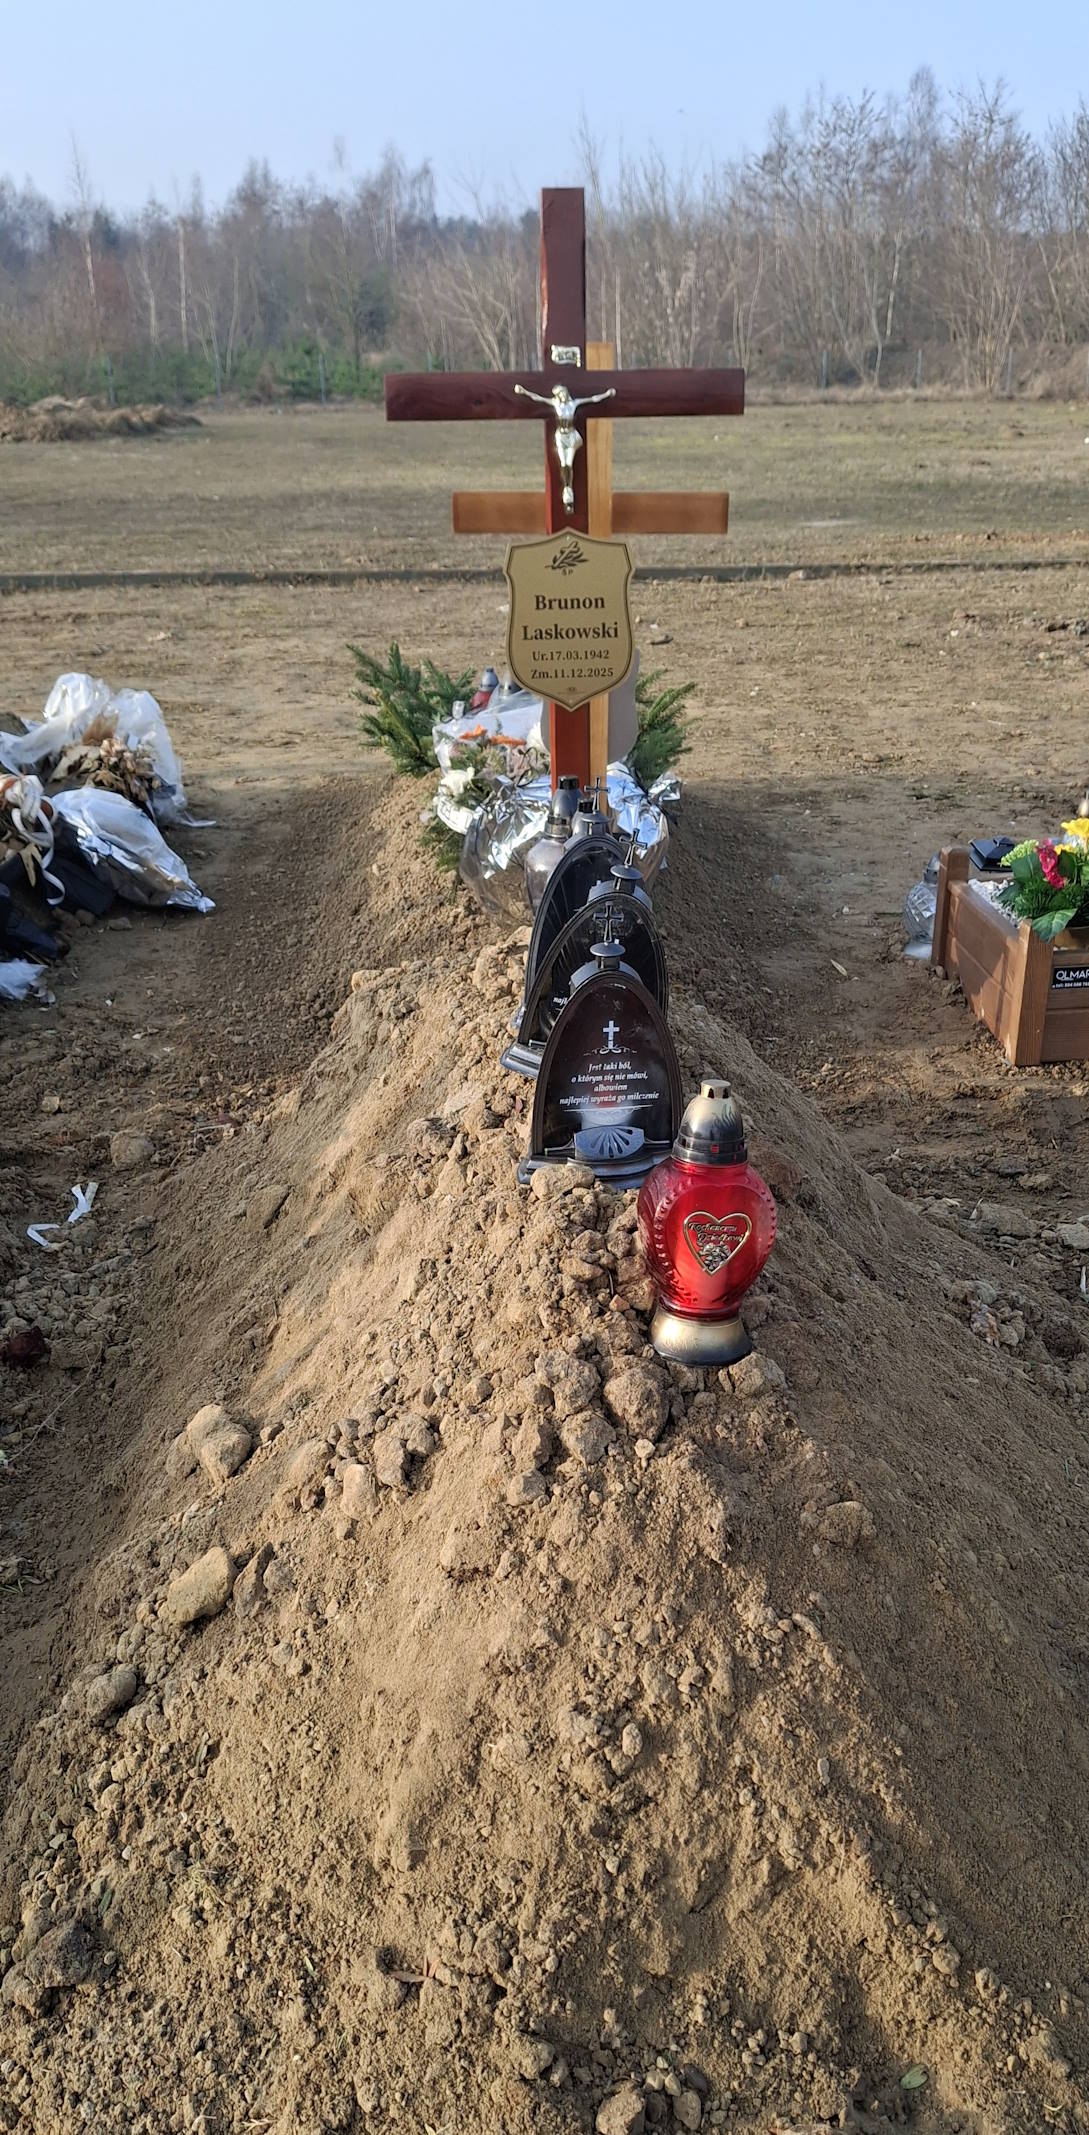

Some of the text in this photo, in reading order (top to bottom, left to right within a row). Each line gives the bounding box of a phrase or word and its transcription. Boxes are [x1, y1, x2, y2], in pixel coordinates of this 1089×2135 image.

[535, 594, 605, 610] Brunon
[522, 622, 618, 640] Laskowski
[532, 650, 610, 661] Ur.17.03.1942
[531, 668, 614, 680] Zm.11.12.2025
[588, 1064, 602, 1073] Jest
[604, 1062, 617, 1070] taki
[578, 1074, 602, 1084] którym
[604, 1073, 613, 1082] się
[627, 1071, 648, 1080] mówi,
[594, 1084, 628, 1092] albowiem
[560, 1092, 660, 1106] najlepiej wyraża go milczenie
